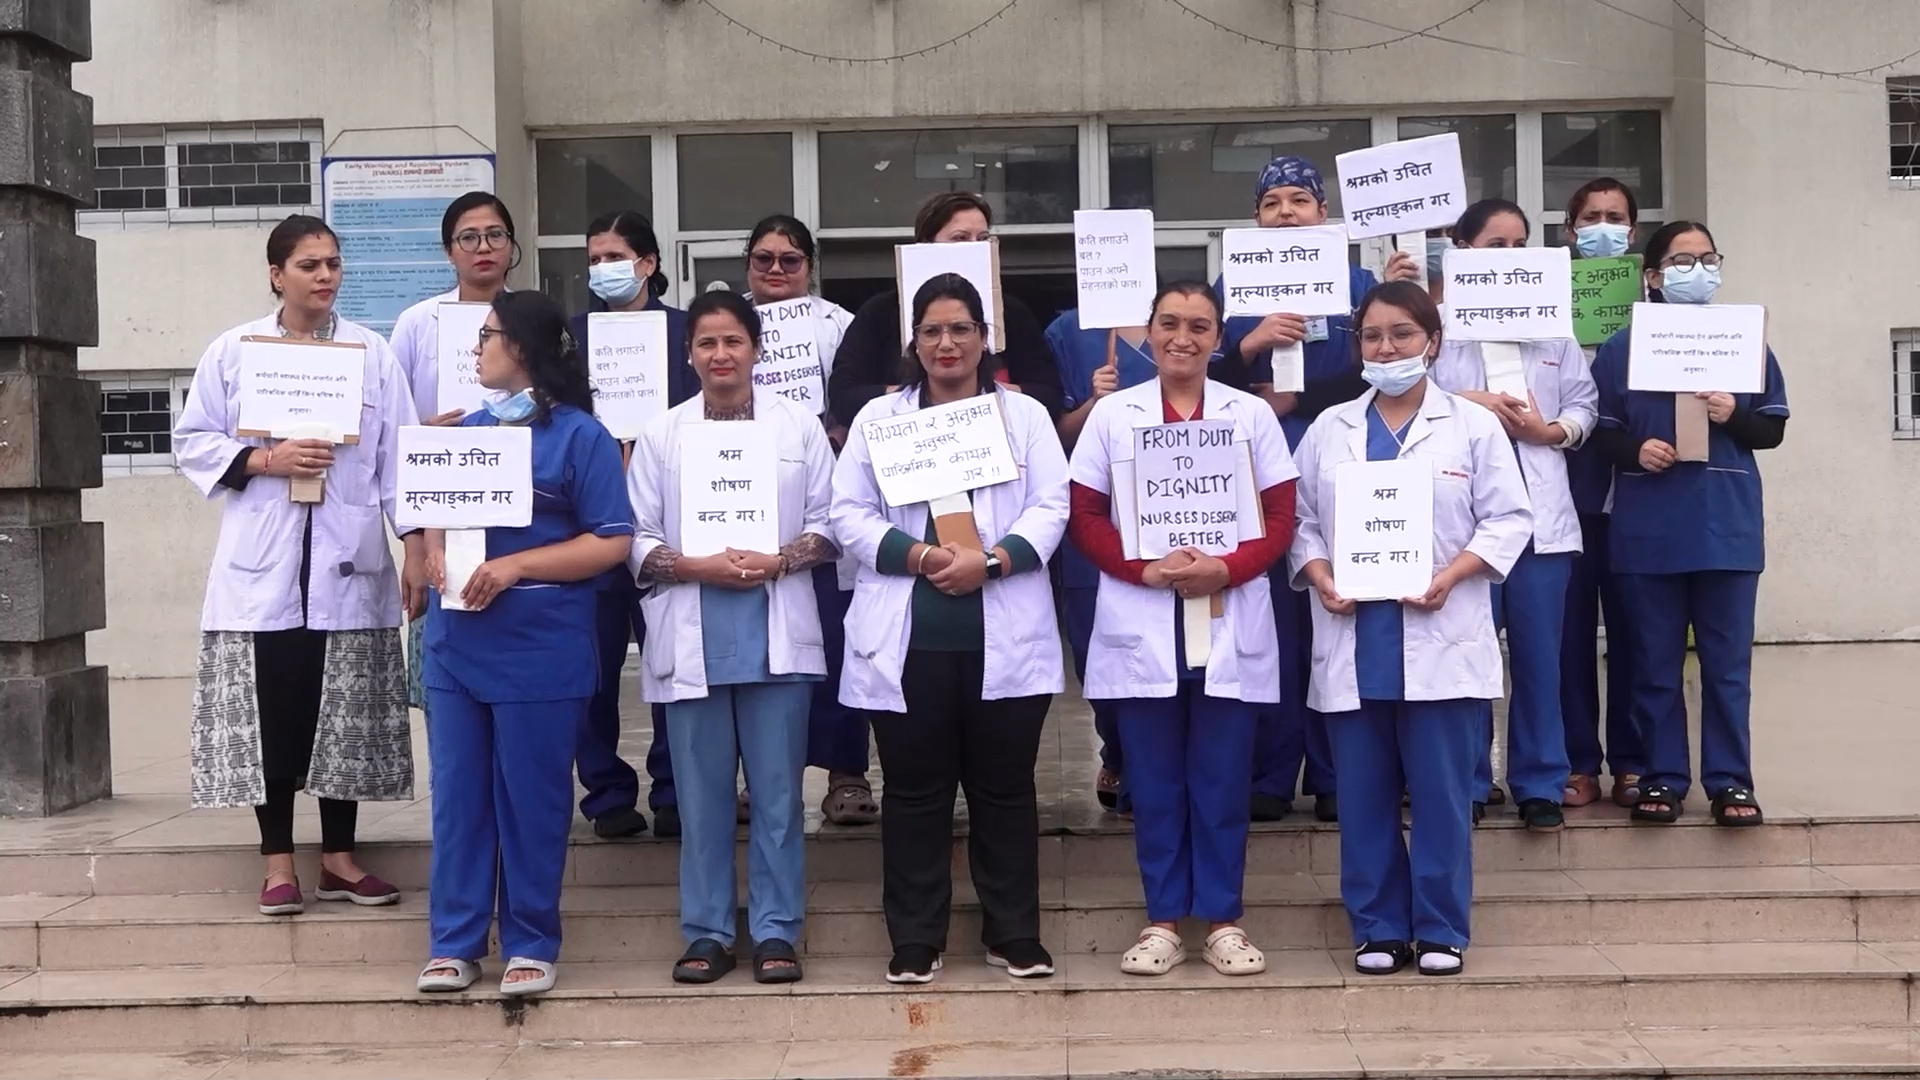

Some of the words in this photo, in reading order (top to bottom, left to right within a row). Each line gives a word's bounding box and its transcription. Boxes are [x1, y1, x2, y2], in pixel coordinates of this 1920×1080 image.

[1346, 168, 1388, 188] श्रमको
[1393, 162, 1432, 180] उचित
[1352, 198, 1424, 226] मूल्याङ्कन
[1430, 193, 1450, 206] गर
[1079, 234, 1095, 245] कति
[1099, 232, 1128, 244] लगाउने
[1080, 252, 1092, 260] बल
[1229, 248, 1273, 264] श्रमको
[1279, 246, 1320, 263] उचित
[1080, 268, 1102, 276] पाउन
[1454, 270, 1497, 285] श्रमको
[1503, 268, 1543, 285] उचित
[1587, 266, 1629, 286] अनुभव
[1080, 278, 1117, 290] मेहनतको
[1230, 284, 1307, 304] मूल्याङ्कन
[1313, 282, 1334, 294] गर
[1572, 288, 1603, 302] नुसार
[779, 302, 811, 321] DUTY
[1455, 307, 1531, 326] मूल्याङ्कन
[1537, 306, 1557, 318] गर
[595, 346, 612, 356] कति
[616, 343, 645, 355] लगाउने
[761, 342, 812, 365] GNITY
[596, 363, 610, 371] बल
[784, 365, 820, 382] DESERVE
[596, 377, 619, 387] पाउन
[868, 422, 918, 442] योग्यता
[945, 403, 992, 427] अनुभव
[913, 431, 960, 454] अनुसार
[1143, 429, 1190, 450] FROM
[1199, 428, 1234, 447] DUTY
[406, 449, 452, 466] श्रमको
[459, 448, 501, 466] उचित
[718, 450, 743, 460] श्रम
[949, 446, 992, 464] कायम
[1173, 456, 1193, 471] TO
[963, 467, 984, 481] गर
[711, 477, 752, 491] शोषण
[1147, 474, 1232, 499] DIGNITY
[405, 491, 485, 511] मूल्याङ्कन
[491, 491, 513, 504] गर
[1373, 488, 1398, 500] श्रम
[698, 511, 727, 523] बन्द
[1141, 511, 1198, 526] NURSES
[1202, 510, 1237, 525] DESERVE
[1365, 517, 1406, 532] शोषण
[1169, 531, 1227, 548] BETTER
[1351, 552, 1380, 564] बन्द
